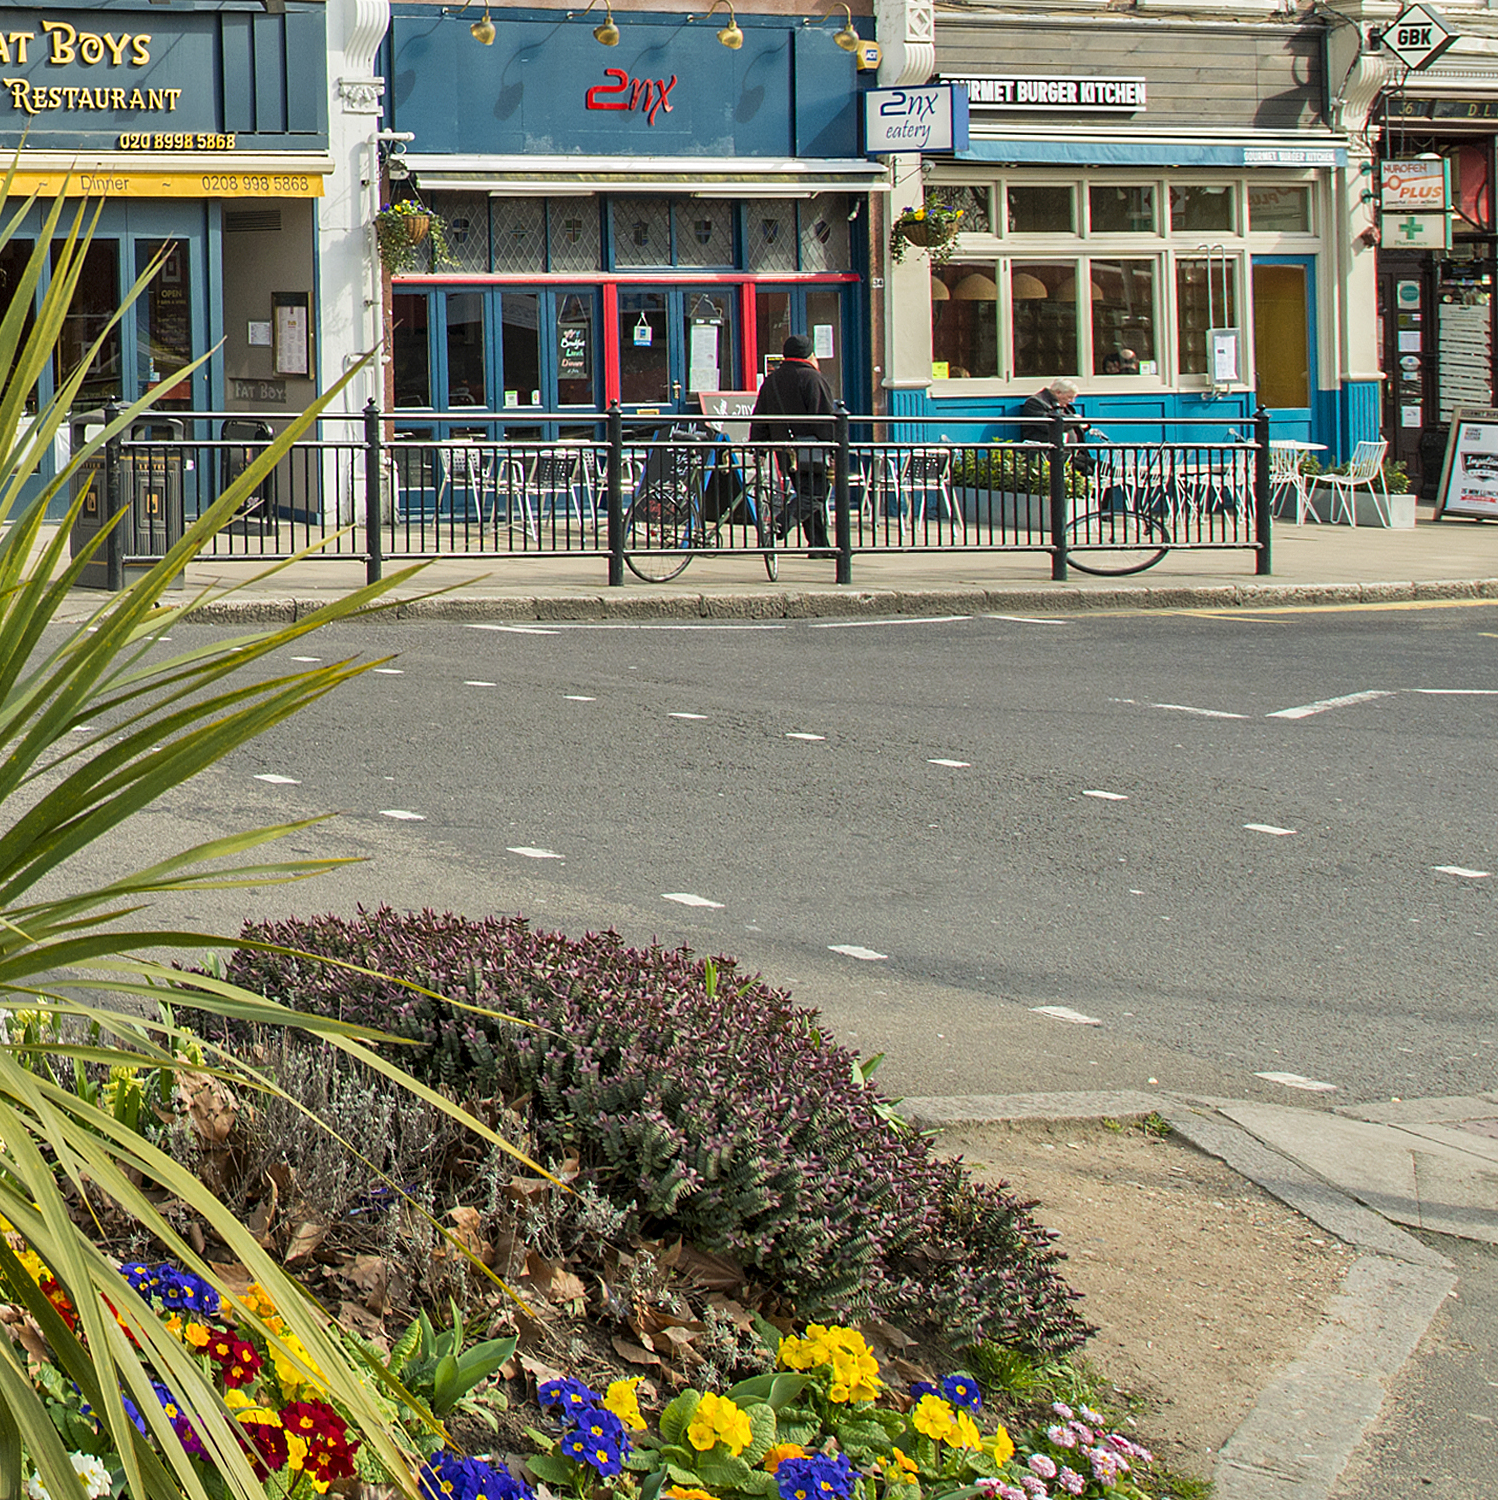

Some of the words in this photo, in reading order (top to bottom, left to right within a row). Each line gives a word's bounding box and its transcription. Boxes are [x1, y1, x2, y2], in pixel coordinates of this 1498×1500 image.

[1397, 28, 1433, 46] GBK
[1017, 81, 1078, 103] BURGER
[1080, 82, 1147, 104] KITCHEN
[120, 133, 152, 150] 020
[154, 133, 194, 150] 8998
[197, 133, 237, 150] 5868
[886, 119, 931, 148] eatery
[1383, 163, 1428, 173] NUROFEN
[80, 175, 129, 191] Dinner
[201, 175, 239, 191] 0208
[243, 176, 270, 191] 998
[274, 176, 309, 191] 5868
[1399, 186, 1442, 198] PLUS
[161, 289, 182, 298] OPEN
[259, 381, 286, 399] BOY
